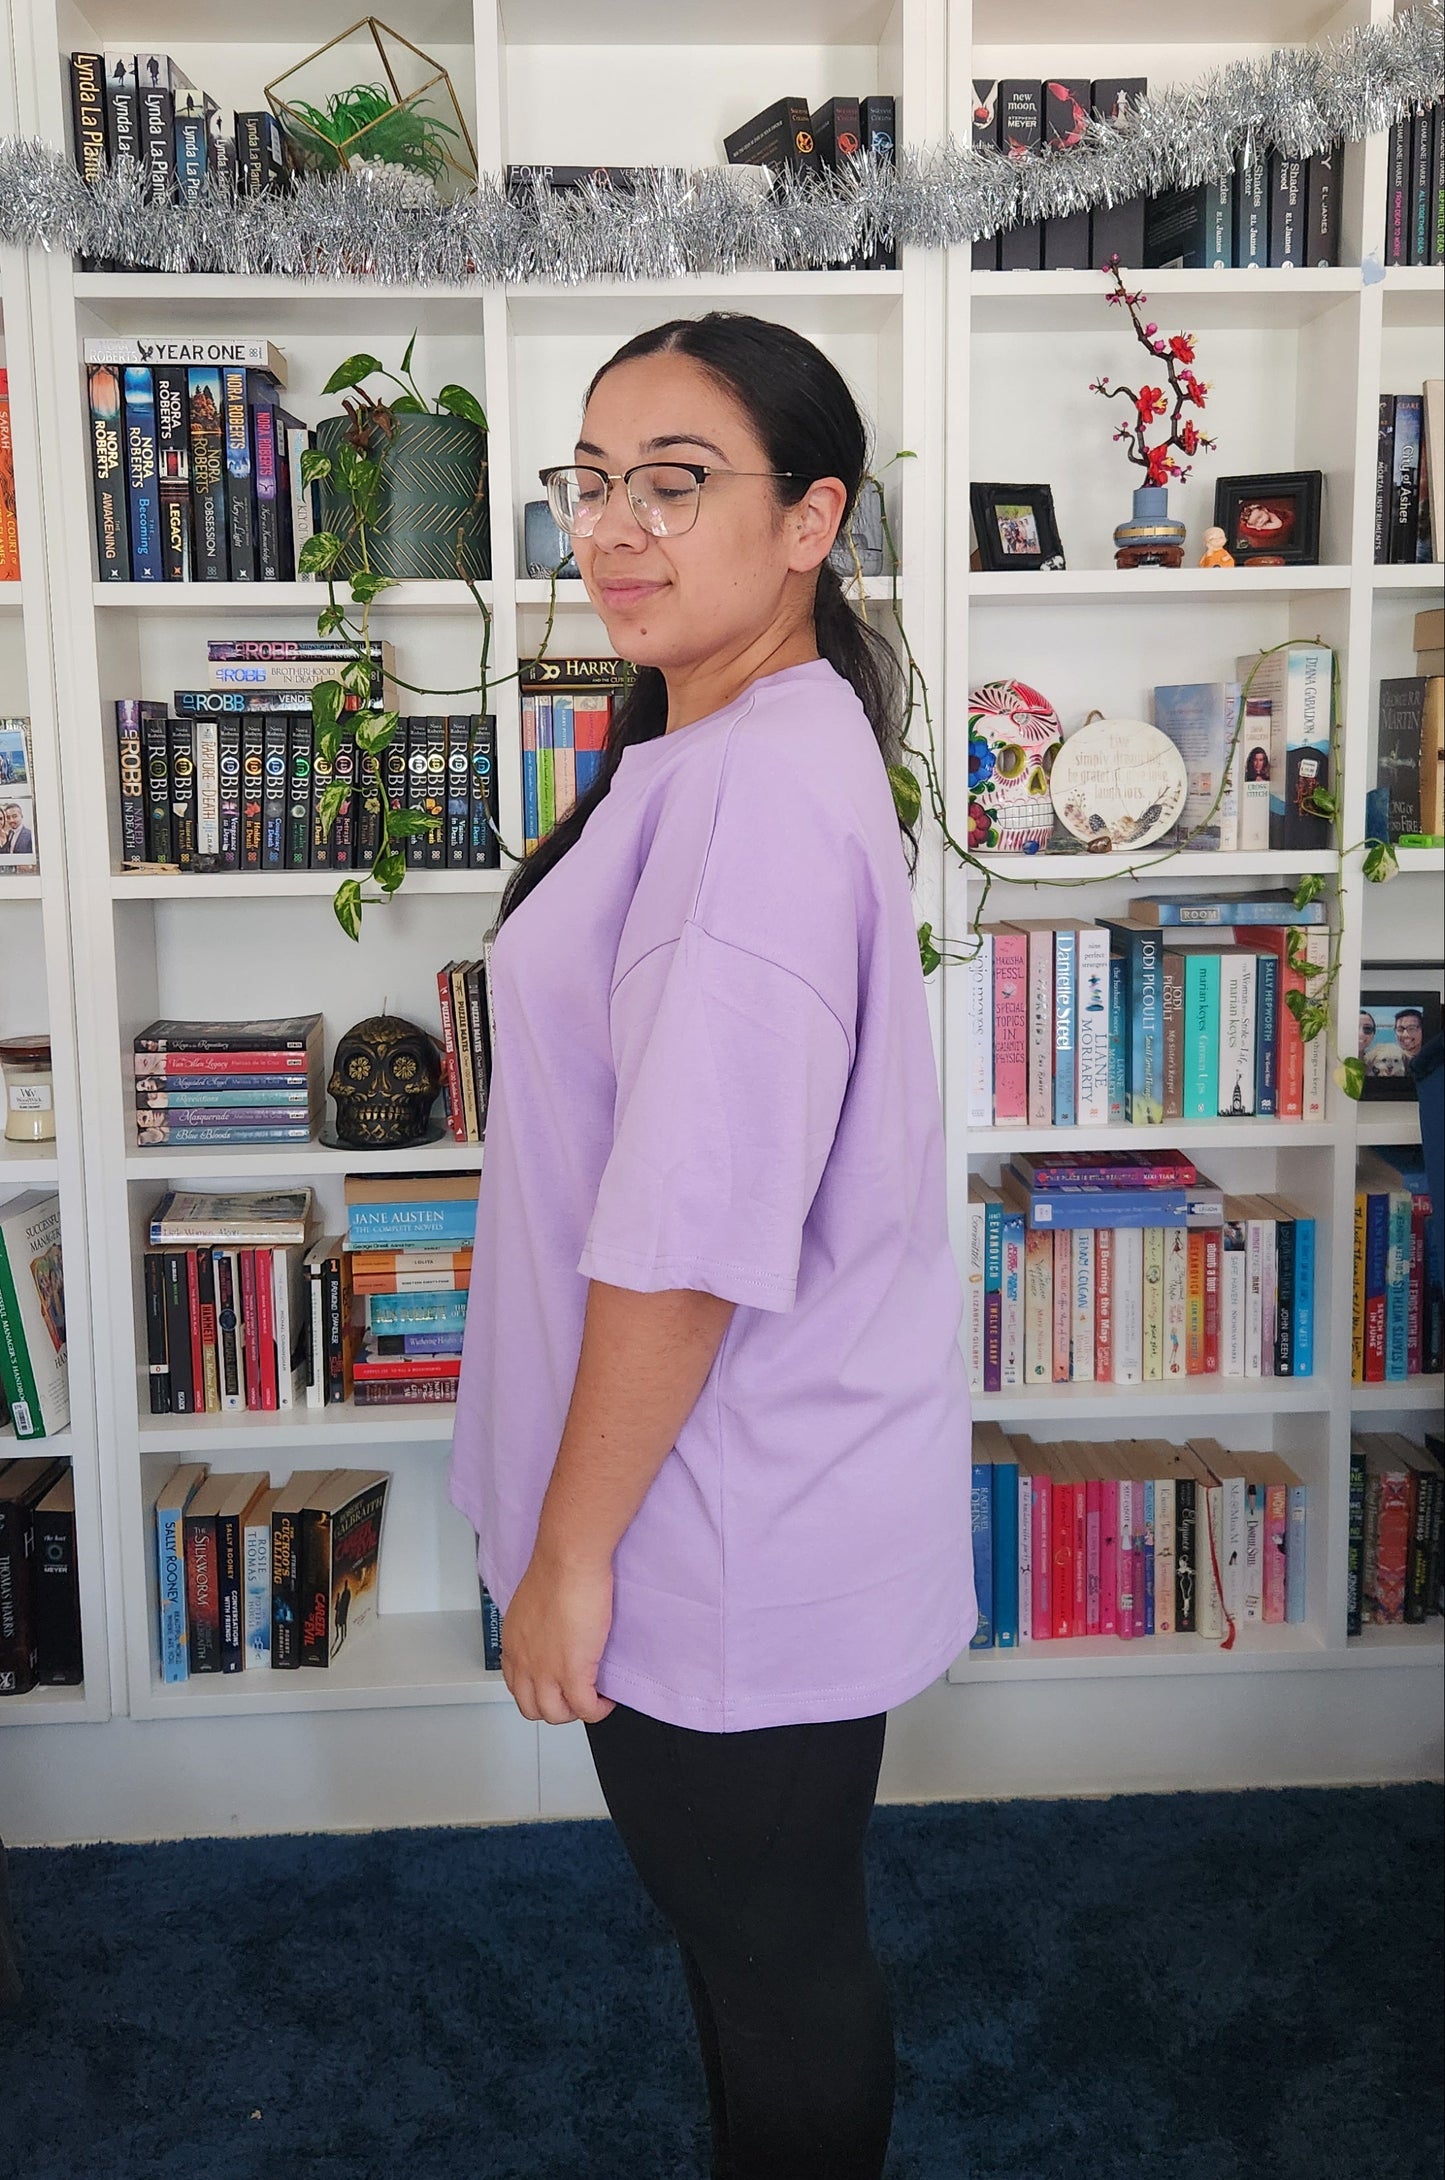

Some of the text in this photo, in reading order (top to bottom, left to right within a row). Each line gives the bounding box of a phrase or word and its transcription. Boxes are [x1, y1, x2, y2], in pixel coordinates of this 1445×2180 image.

[74, 54, 103, 183] Lynda La Plante
[1008, 102, 1036, 112] moon
[1013, 93, 1033, 101] new
[113, 95, 132, 158] Lynda La
[1008, 120, 1036, 128] MEYER
[147, 94, 169, 204] Lynda La Plante
[214, 139, 226, 172] Lynda
[511, 166, 553, 181] FOUR
[1253, 164, 1264, 207] Shades
[1280, 162, 1289, 191] Freed
[1289, 163, 1300, 206] Shades
[155, 345, 245, 360] YEAR ONE
[0, 412, 10, 449] SARAH
[159, 381, 172, 439] ROBERTS
[170, 391, 181, 429] NORA
[227, 374, 246, 450] NORA ROBERTS
[95, 421, 109, 479] ROBERTS
[107, 431, 119, 469] NORA
[129, 427, 143, 488] ROBERTS
[142, 437, 154, 482] NORA
[193, 438, 209, 493] ROBERTS
[208, 449, 221, 483] NORA
[257, 412, 273, 476] NORA ROBERTS
[1400, 445, 1414, 524] City of Ashes
[102, 492, 116, 559] AWAKENING
[138, 498, 150, 555] Becoming
[169, 503, 182, 552] LEGACY
[204, 501, 216, 557] OBSESSION
[1376, 495, 1384, 550] INSTRUMENTS
[271, 668, 336, 676] BROTHERHOOD
[295, 675, 323, 683] DEATH
[566, 661, 619, 676] HARRY
[1304, 657, 1318, 734] DIANA GABALDON
[1382, 711, 1421, 730] MARTIN
[124, 802, 135, 848] IN DEATH
[134, 808, 144, 845] NAKED
[253, 822, 261, 849] Holiday
[458, 820, 466, 845] Visions
[1401, 816, 1418, 833] FIRE
[1183, 910, 1217, 919] ROOM
[996, 957, 1024, 965] MARISHA
[996, 967, 1024, 979] PESSL
[1084, 952, 1105, 960] perfect
[996, 1003, 1025, 1013] SPECIAL
[1056, 936, 1074, 1050] Danielle Steel
[1141, 940, 1156, 1032] JODI PICOULT
[1163, 975, 1173, 1022] PICOULT
[1172, 985, 1183, 1011] JODI
[1197, 968, 1208, 1032] marian keyes
[1264, 961, 1274, 1042] SALLY HEPWORTH
[996, 1016, 1025, 1026] TOPICS
[1003, 1029, 1016, 1039] IN
[1227, 979, 1240, 1048] marian keyes
[1236, 972, 1250, 1065] Woman Stole Life
[996, 1053, 1025, 1063] PHYSICS
[1081, 1020, 1094, 1103] MORIARTY
[1095, 1034, 1107, 1088] LIANE
[1108, 1049, 1116, 1098] MORIARTY
[1116, 1058, 1125, 1088] LIANE
[1166, 1030, 1176, 1094] My Sister's Keeper
[176, 1129, 231, 1140] Blue Bloods
[353, 1210, 444, 1224] JANE AUSTEN
[970, 1215, 983, 1267] Committed
[989, 1221, 1000, 1278] EVANOVICH
[331, 1260, 337, 1272] 1
[1078, 1236, 1089, 1309] JENNY COLGAN
[1099, 1250, 1110, 1343] Burning the Map
[1230, 1277, 1238, 1306] HAVEN
[1408, 1279, 1418, 1348] IT ENDS WITH US
[989, 1303, 998, 1365] TWELVE SHARP
[1280, 1307, 1289, 1359] JOHN GREEN
[1369, 1311, 1377, 1348] IN JUNE
[1393, 1280, 1404, 1375] IT STARTS WITH US
[335, 1498, 383, 1538] GALBRAITH
[980, 1487, 989, 1530] RACHAEL
[1177, 1507, 1196, 1552] Elegance
[1416, 1479, 1427, 1542] EVELYN HUGO
[165, 1522, 179, 1603] SALLY ROONEY
[248, 1532, 257, 1581] THOMAS
[258, 1538, 266, 1574] ROSIE
[273, 1531, 282, 1584] CALLING
[281, 1518, 290, 1576] CUCKOO'S
[1246, 1520, 1259, 1568] DANIELLE STEEL
[194, 1534, 209, 1606] SILKWORM
[1, 1556, 13, 1637] THOMAS HARRIS
[314, 1593, 325, 1637] CAREER
[304, 1621, 314, 1645] EVIL
[489, 1604, 499, 1648] DAUGHTER
